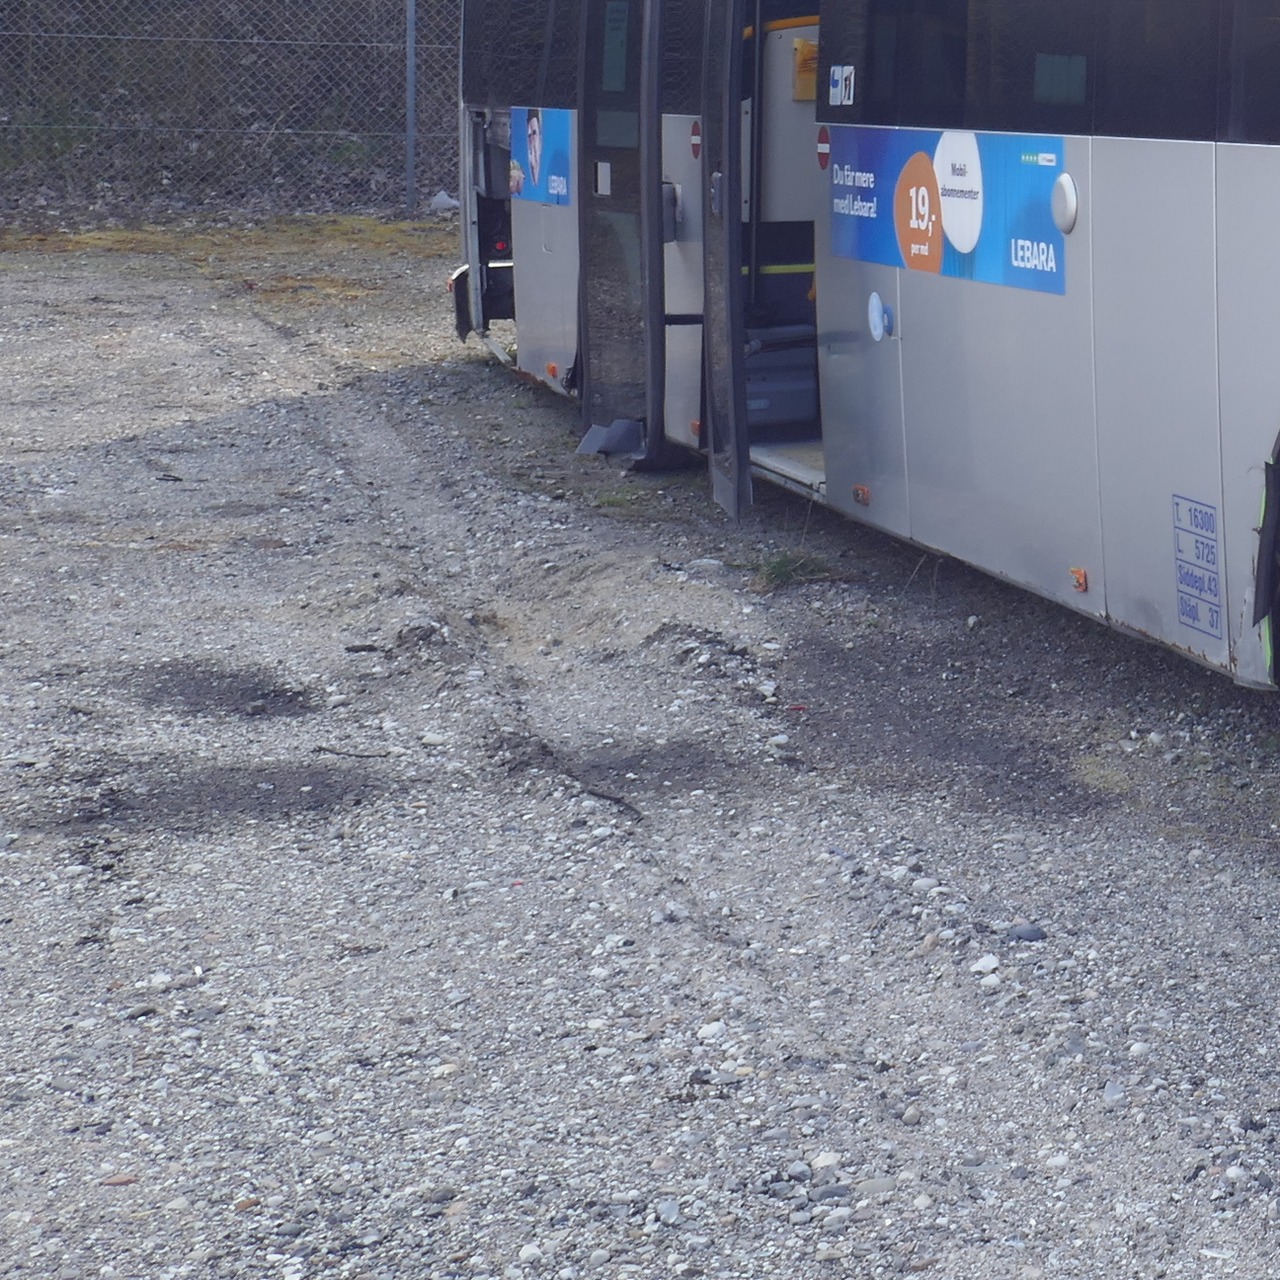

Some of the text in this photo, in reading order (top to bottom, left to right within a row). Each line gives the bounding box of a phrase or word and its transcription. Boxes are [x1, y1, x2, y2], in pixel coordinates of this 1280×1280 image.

[833, 164, 844, 185] Du
[855, 170, 875, 188] mere
[833, 194, 877, 218] med Lebara!
[1011, 238, 1056, 272] LEBARA
[1188, 508, 1215, 533] 16300
[1195, 540, 1215, 565] 5725
[1208, 607, 1219, 630] 37
